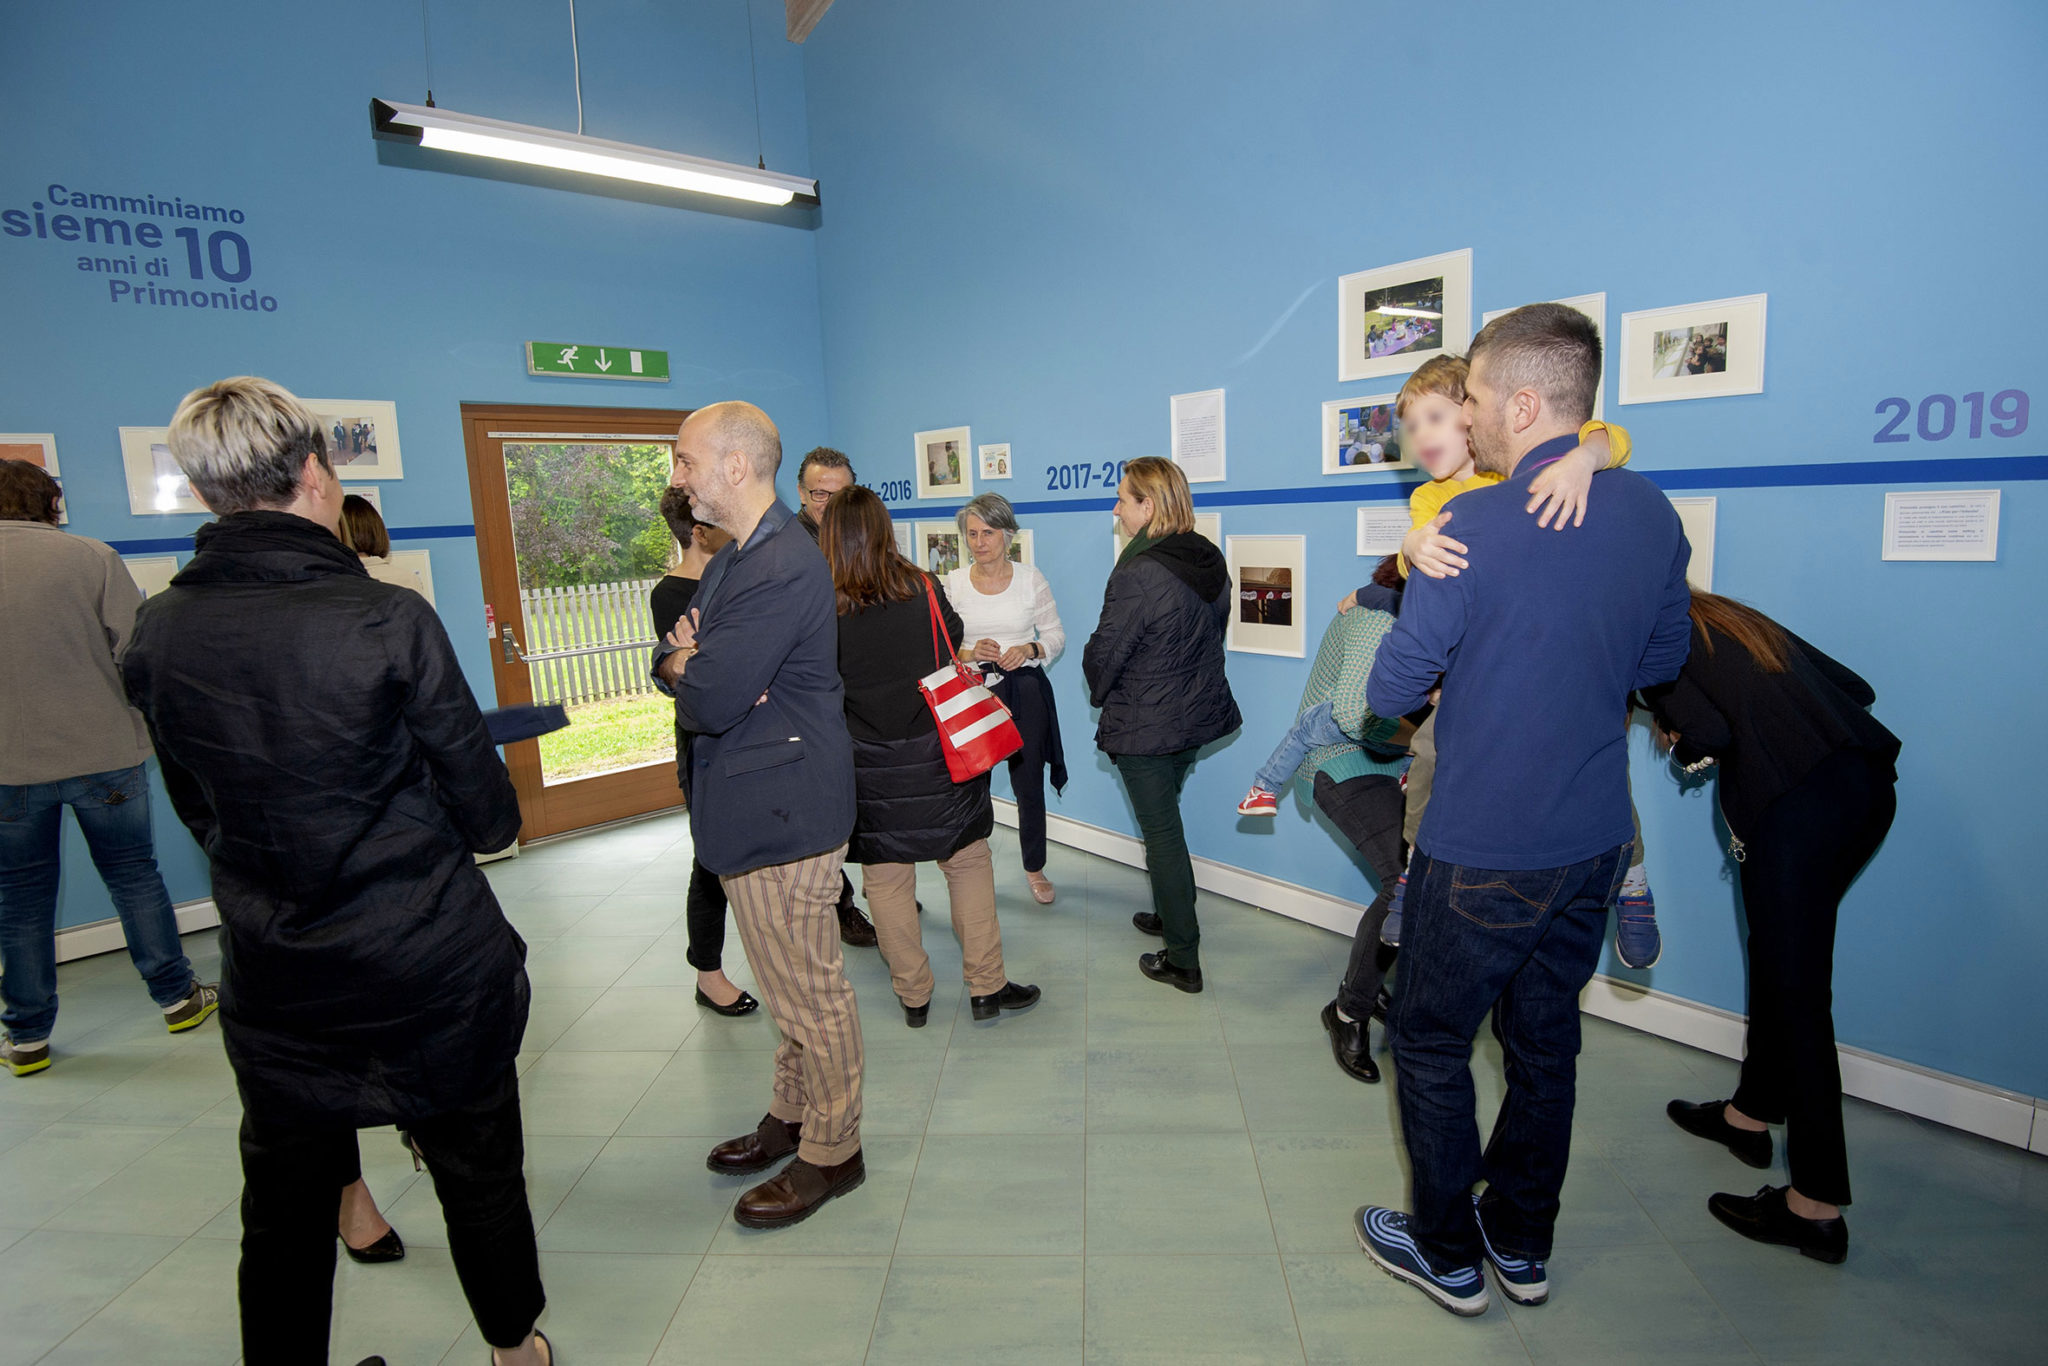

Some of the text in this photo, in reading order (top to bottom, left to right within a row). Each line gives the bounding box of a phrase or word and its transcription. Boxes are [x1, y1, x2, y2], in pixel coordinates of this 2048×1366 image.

[48, 184, 245, 225] Camminiamo
[77, 255, 169, 277] anni di
[175, 226, 251, 283] 10
[109, 279, 278, 312] Primonido
[1873, 388, 2030, 443] 2019
